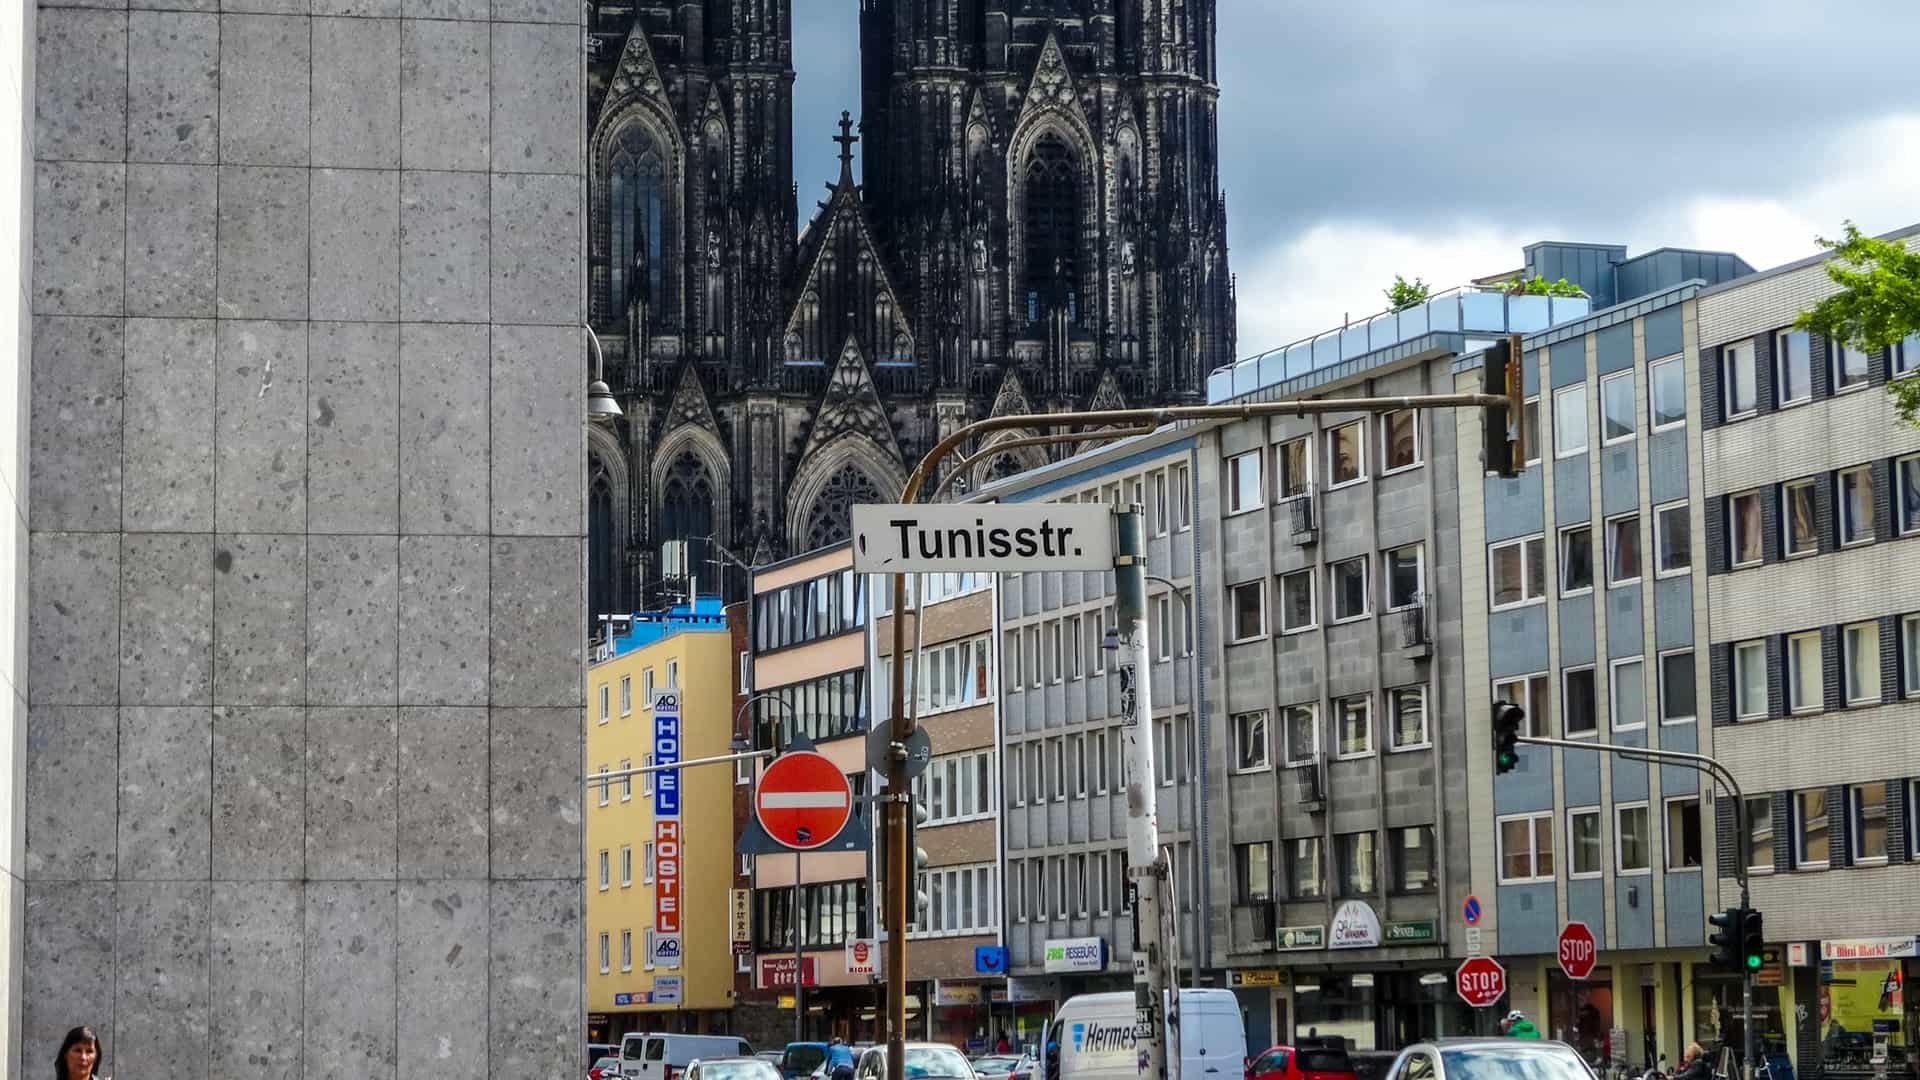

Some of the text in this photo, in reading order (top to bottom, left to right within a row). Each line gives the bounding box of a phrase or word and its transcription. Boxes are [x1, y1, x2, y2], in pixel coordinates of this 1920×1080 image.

[890, 519, 1082, 559] Tunisstr.
[656, 719, 677, 809] HOTEL
[657, 823, 677, 931] HOSTEL
[1561, 939, 1593, 961] STOP
[1462, 971, 1499, 992] STOP
[1086, 1022, 1137, 1051] Hermes
